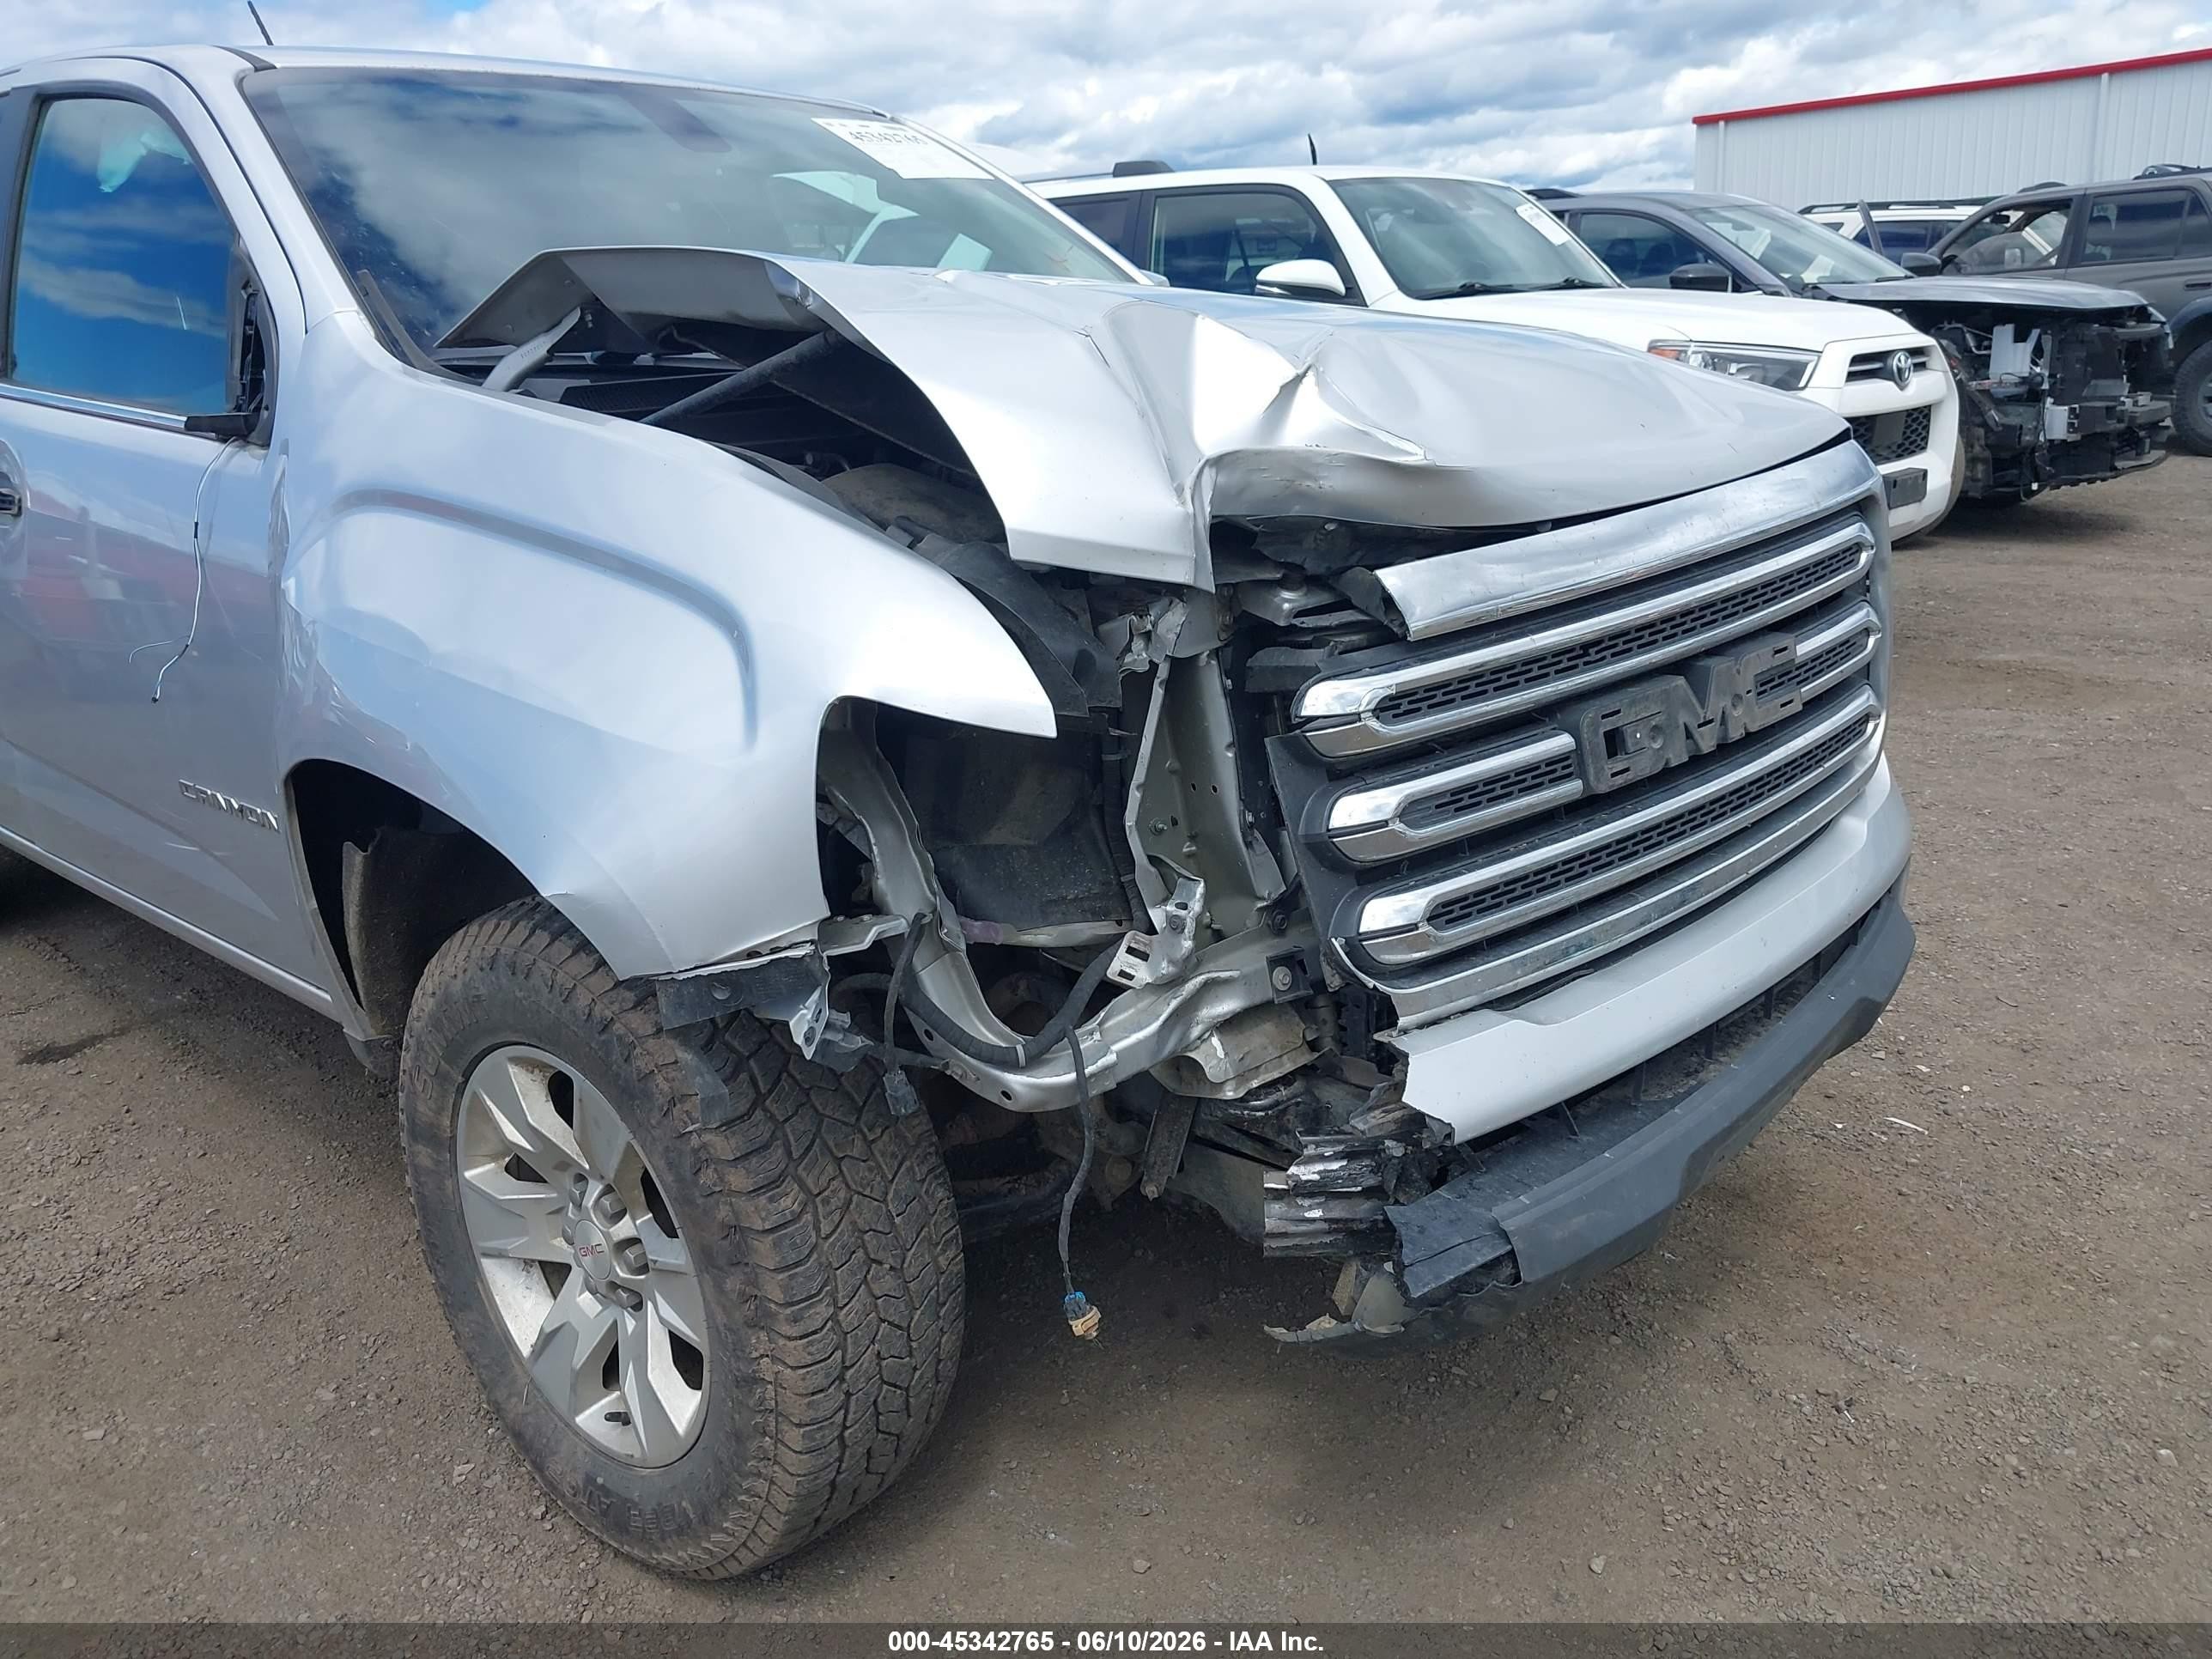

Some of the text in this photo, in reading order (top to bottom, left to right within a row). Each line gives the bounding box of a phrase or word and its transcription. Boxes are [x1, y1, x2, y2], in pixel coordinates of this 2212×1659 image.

[1581, 634, 1802, 793] GMC
[179, 778, 282, 833] CANYON
[579, 1243, 605, 1257] GMC
